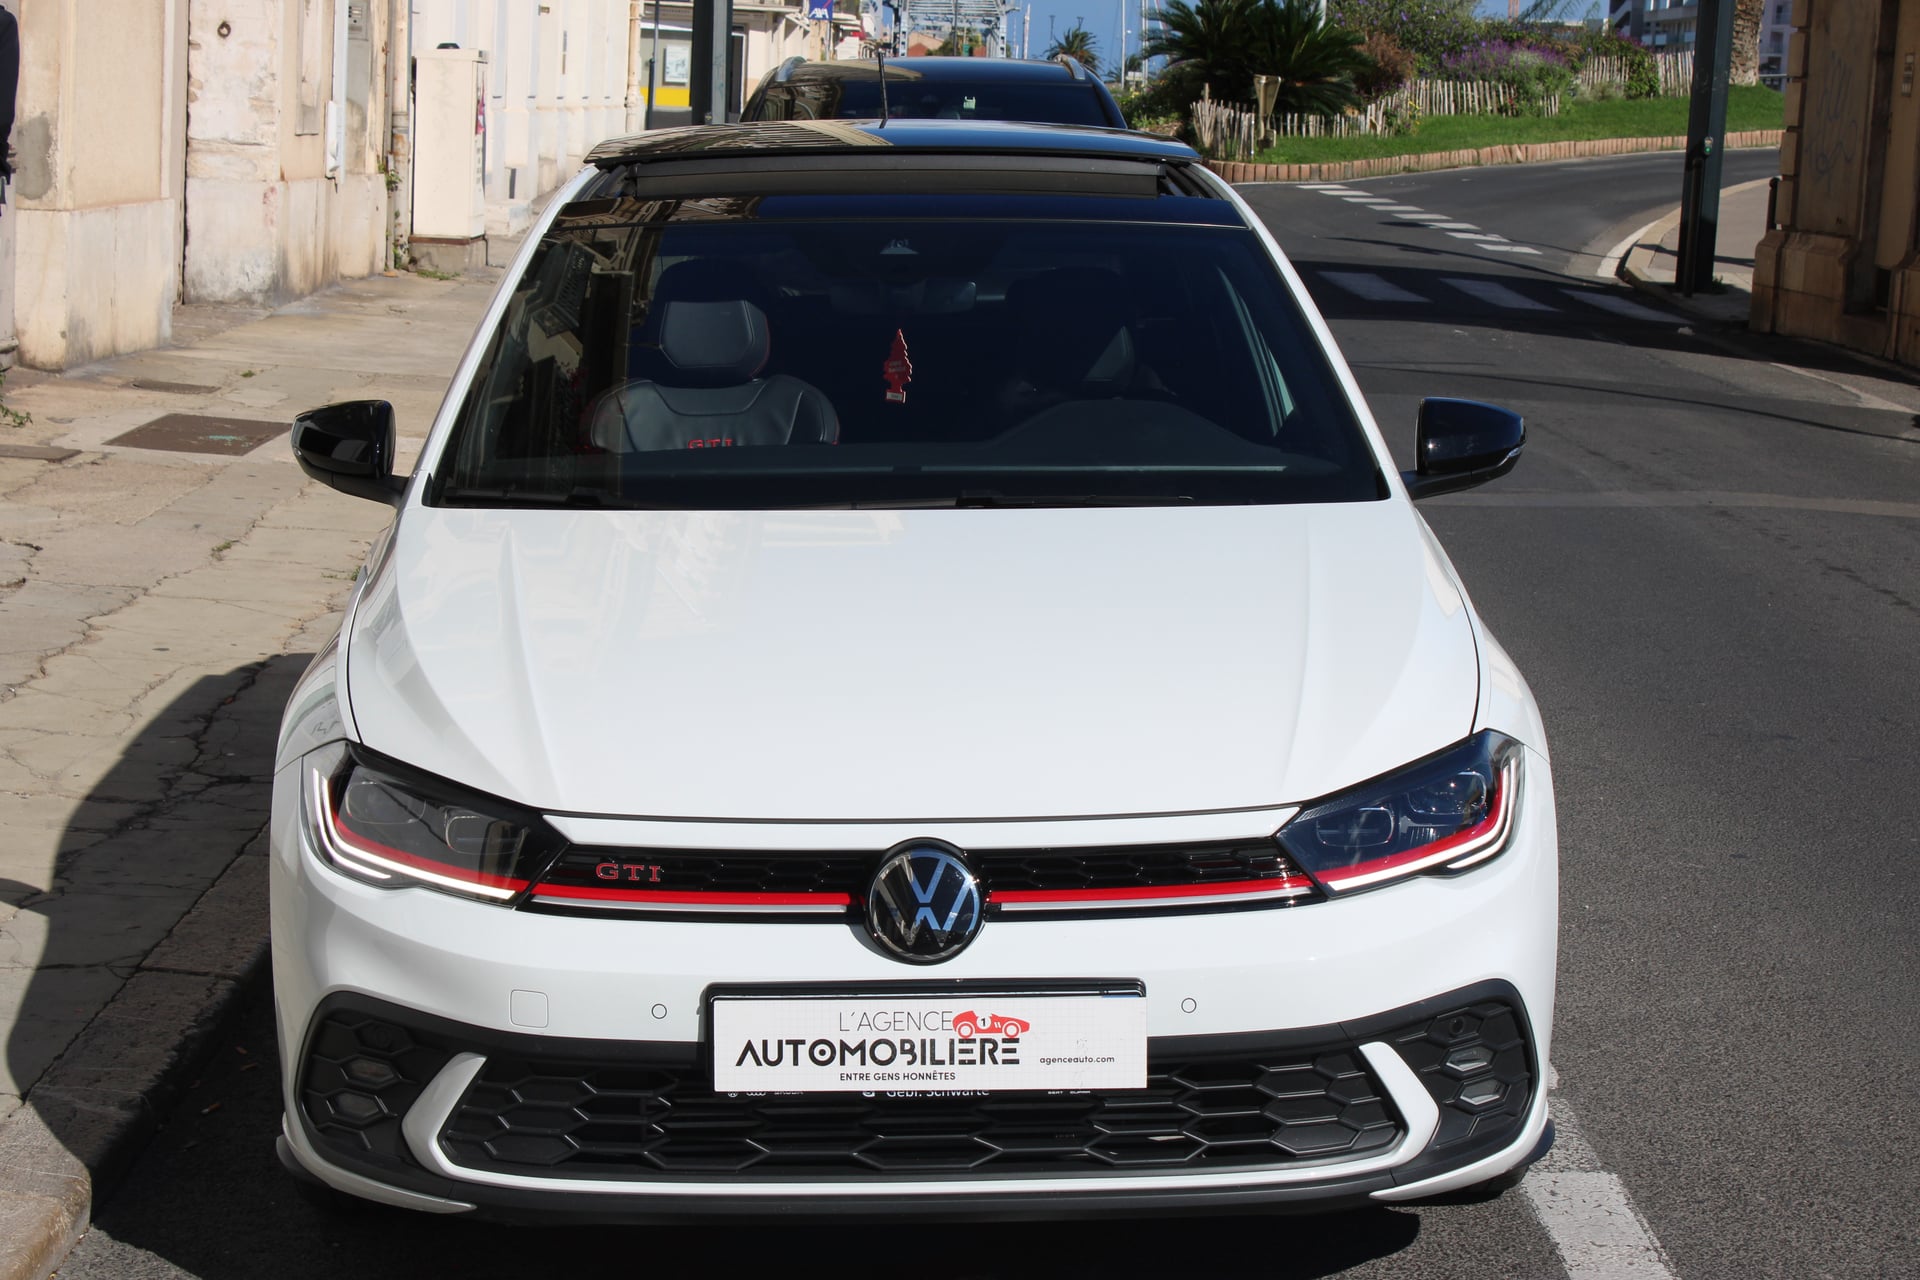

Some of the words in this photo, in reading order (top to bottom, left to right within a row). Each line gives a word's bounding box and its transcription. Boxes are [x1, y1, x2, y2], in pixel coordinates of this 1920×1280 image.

[808, 8, 829, 19] AXA
[595, 862, 661, 882] GTI
[874, 850, 977, 950] VW
[839, 1011, 953, 1032] L'AGENCE
[980, 1017, 986, 1027] 1
[1039, 1056, 1115, 1066] agenceauto.com
[839, 1073, 871, 1081] ENTRE
[873, 1073, 900, 1081] GENS
[902, 1070, 956, 1081] HONNÊTES
